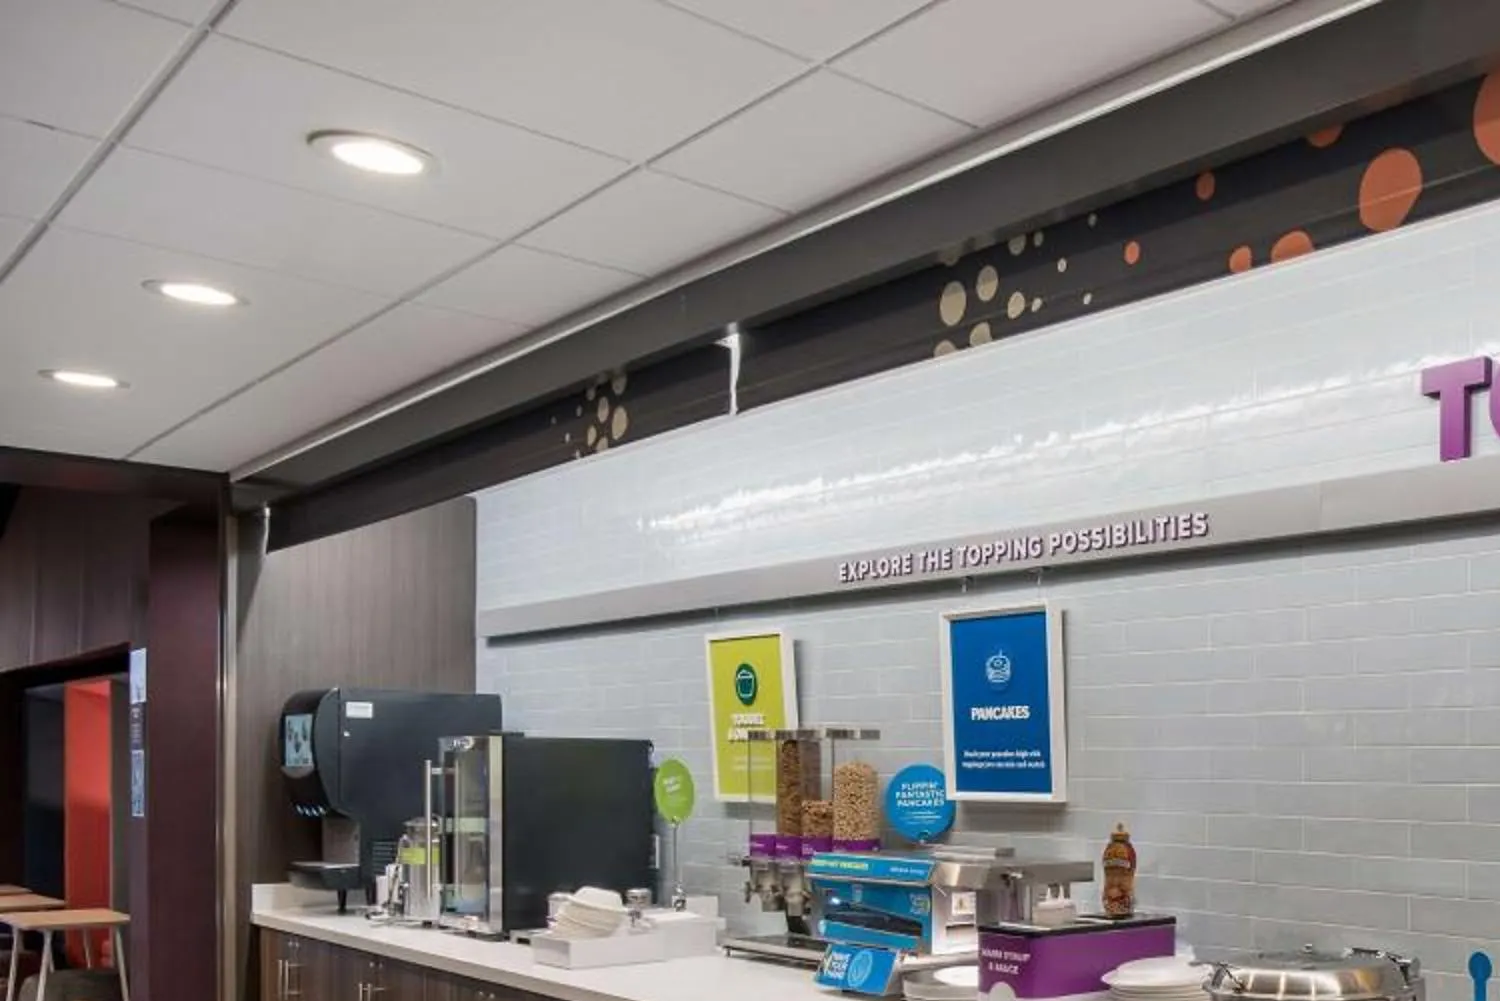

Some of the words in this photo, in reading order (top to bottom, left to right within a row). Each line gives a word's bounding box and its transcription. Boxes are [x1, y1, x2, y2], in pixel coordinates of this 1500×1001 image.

[839, 553, 913, 583] EXPLORE
[919, 547, 952, 572] THE
[957, 537, 1043, 568] TOPPING
[1050, 512, 1210, 556] POSSIBILITIES
[971, 705, 1031, 720] PANCAKES
